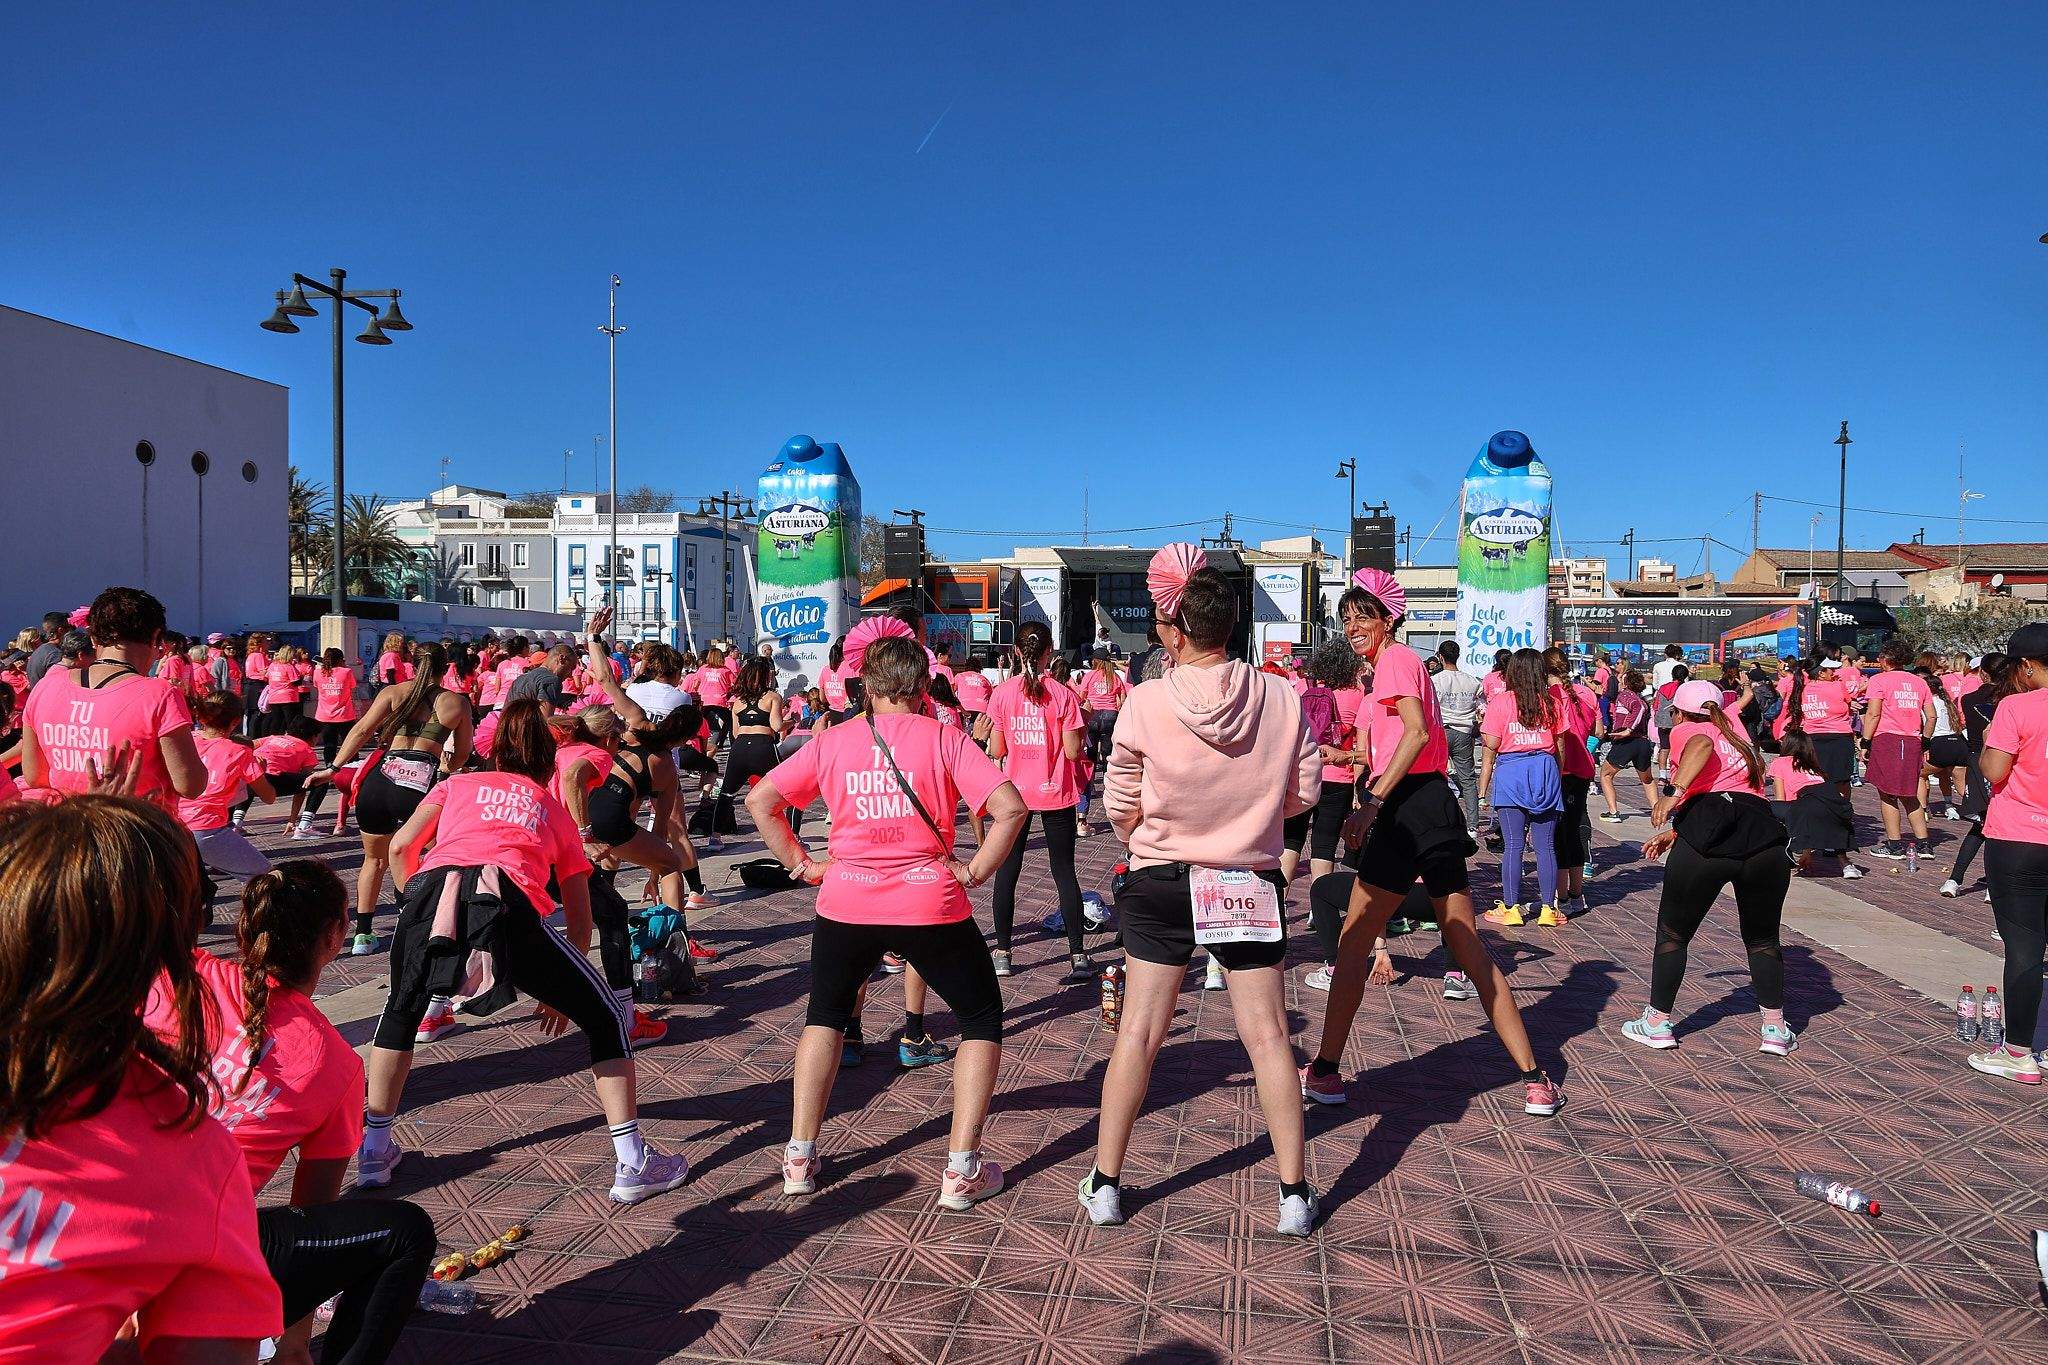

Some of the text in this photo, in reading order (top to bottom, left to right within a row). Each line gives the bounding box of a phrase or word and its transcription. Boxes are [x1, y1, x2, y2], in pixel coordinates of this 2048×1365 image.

[767, 517, 824, 529] ASTURIANA
[1474, 521, 1539, 535] ASTURIANA
[765, 604, 820, 632] Calcio
[1260, 613, 1296, 622] OYSHO
[1471, 603, 1507, 625] Leche
[1562, 607, 1732, 618] portos ARCOS de META PANTALLA LED
[1467, 621, 1538, 648] semi
[1902, 683, 1912, 692] TU
[1894, 691, 1919, 700] DORSAL
[1023, 702, 1038, 716] TU
[1898, 700, 1918, 709] SUMA
[70, 700, 95, 724] TU
[42, 722, 110, 750] DORSAL
[1014, 731, 1046, 746] SUMA
[1514, 733, 1543, 746] SUMA
[398, 768, 418, 777] 016
[508, 781, 534, 797] TU
[475, 785, 549, 826] DORSAL
[856, 794, 915, 821] SUMA
[480, 804, 539, 834] SUMA
[870, 827, 905, 844] 2025
[841, 871, 879, 884] OYSHO
[1223, 897, 1256, 910] 016
[1205, 931, 1234, 939] OYSHO
